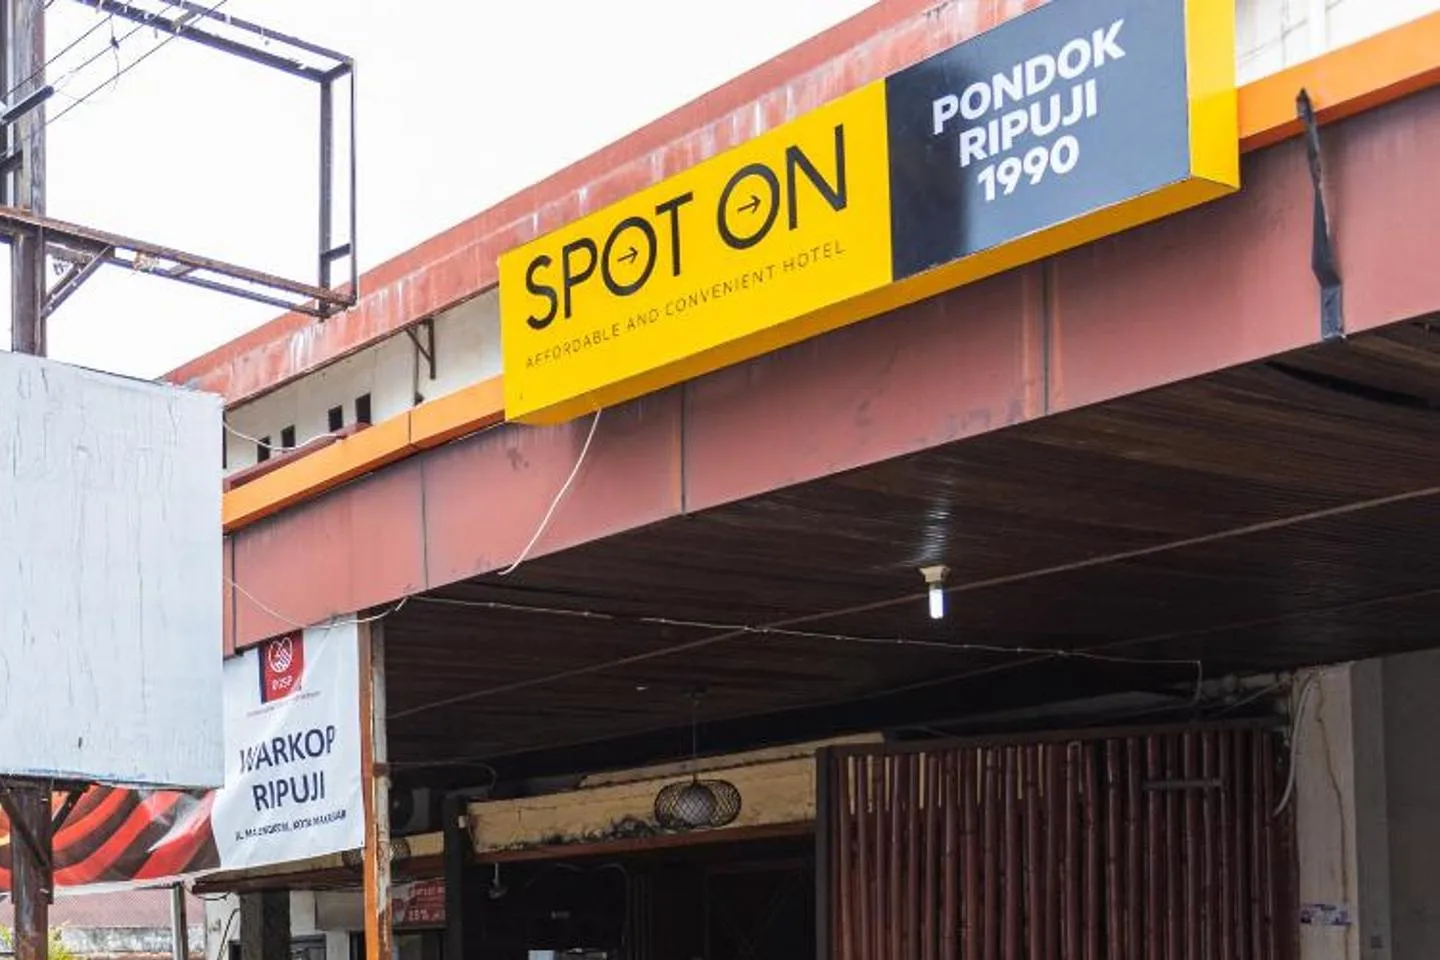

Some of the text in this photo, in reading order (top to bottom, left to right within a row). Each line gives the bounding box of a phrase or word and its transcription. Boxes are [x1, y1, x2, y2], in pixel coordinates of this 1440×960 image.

[933, 18, 1126, 135] PONDOK
[960, 78, 1097, 167] RIPUJI
[978, 135, 1080, 202] 1990
[525, 123, 848, 330] SPOT ON
[525, 239, 847, 369] AFFORDABLE AND CONVENIENT HOTEL
[239, 724, 336, 774] WARKOP
[252, 771, 326, 812] RIPUJI
